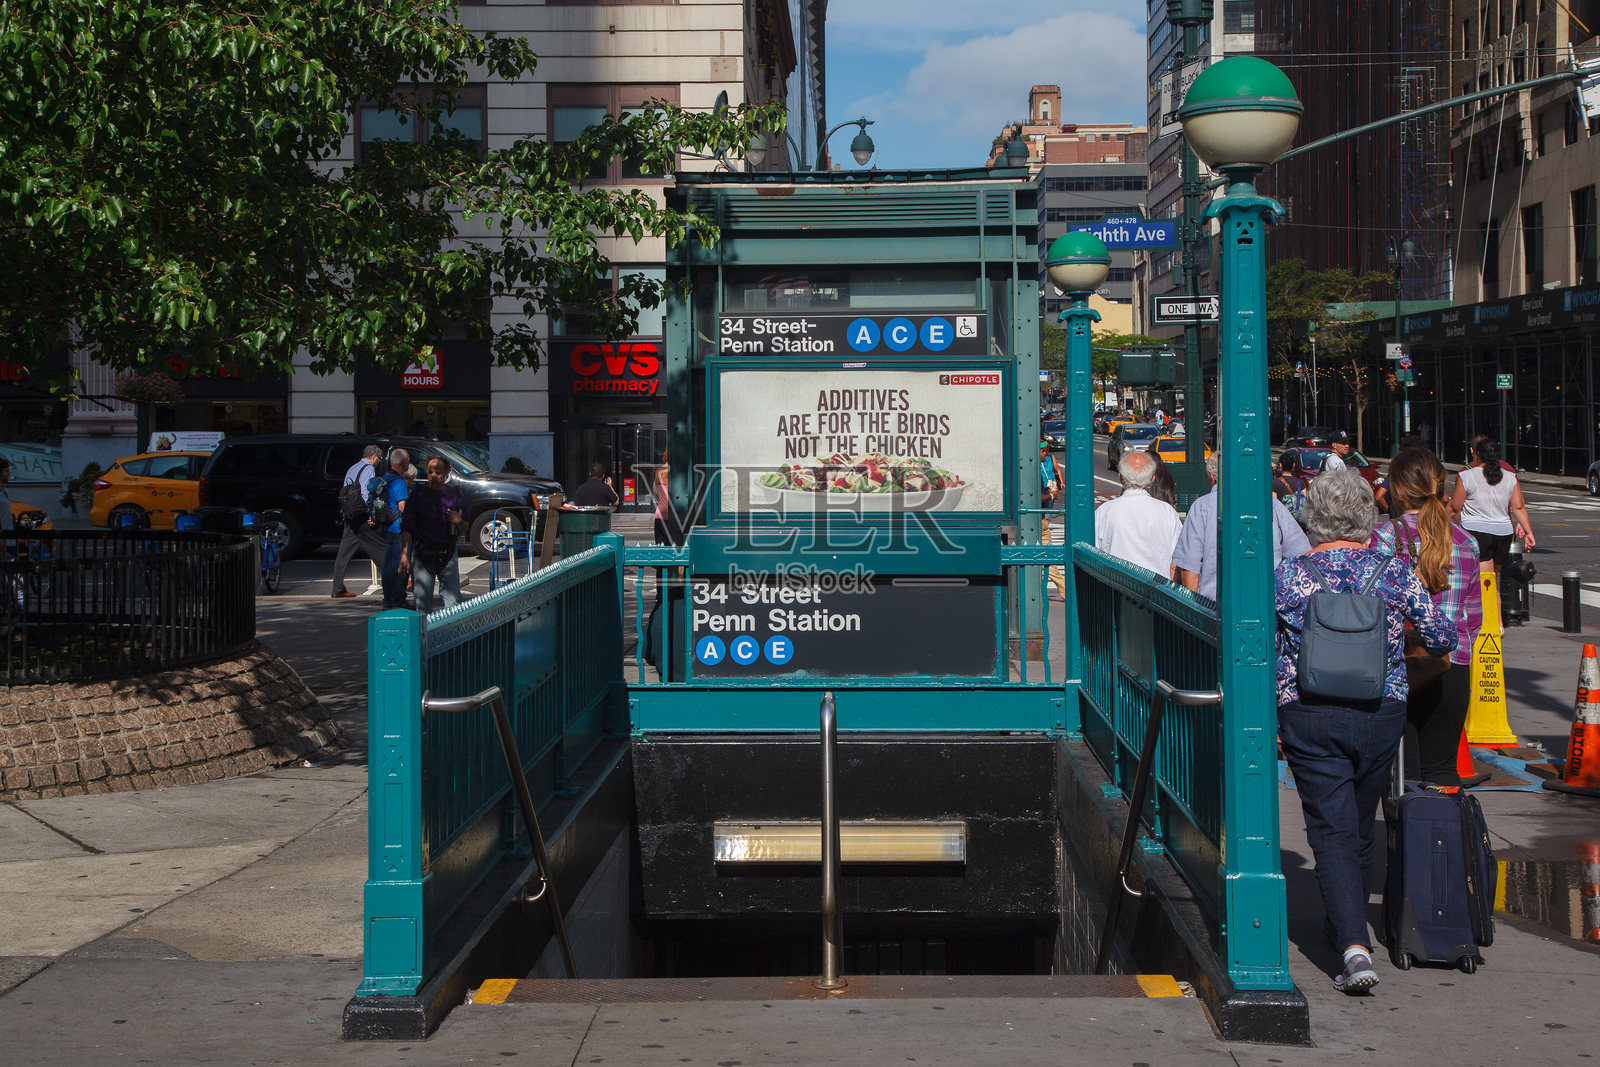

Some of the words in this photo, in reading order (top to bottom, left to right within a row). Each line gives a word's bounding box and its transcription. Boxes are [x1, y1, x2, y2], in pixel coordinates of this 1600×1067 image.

[1079, 226, 1130, 242] ghth
[1134, 226, 1166, 242] Ave
[1167, 304, 1189, 314] ONE
[1198, 303, 1219, 313] WAY
[720, 318, 745, 335] 34
[752, 318, 817, 335] Street-
[855, 325, 872, 344] A
[891, 325, 908, 344] C
[930, 325, 945, 344] E
[720, 337, 764, 353] Penn
[771, 336, 835, 353] Station
[570, 343, 660, 376] CVS
[404, 376, 440, 385] HOURS
[573, 376, 660, 395] pharmacy
[817, 389, 910, 411] ADDITIVES
[777, 413, 812, 437] ARE
[818, 412, 852, 434] FOR
[857, 412, 891, 434] THE
[897, 413, 951, 436] BIRDS
[785, 436, 820, 459] NOT
[825, 435, 859, 457] THE
[865, 435, 942, 459] CHICKEN
[693, 583, 728, 605] 34
[741, 583, 822, 605] Street
[693, 609, 756, 632] Penn
[768, 608, 861, 632] Station
[703, 641, 719, 659] A
[736, 641, 753, 660] C
[772, 641, 786, 659] E
[1479, 656, 1500, 664] CAUTION
